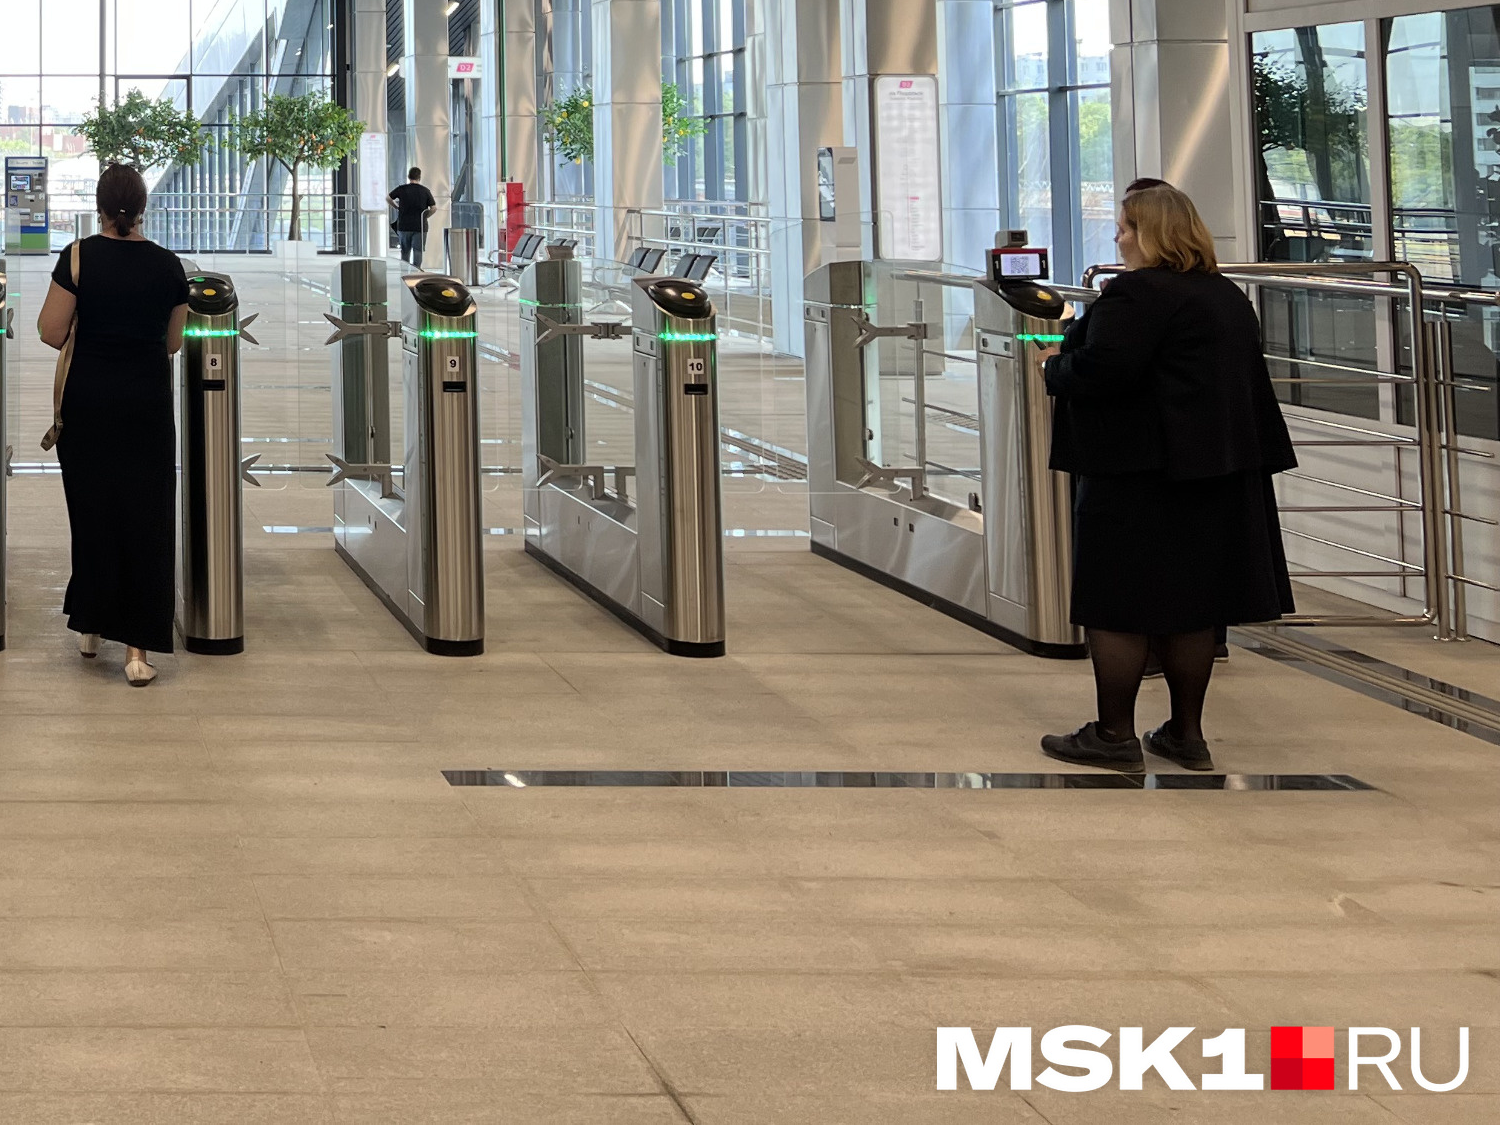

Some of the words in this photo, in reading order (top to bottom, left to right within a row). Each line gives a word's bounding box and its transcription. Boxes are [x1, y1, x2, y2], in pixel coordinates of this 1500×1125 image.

[210, 357, 217, 367] 8
[449, 359, 457, 368] 9
[688, 362, 703, 371] 10
